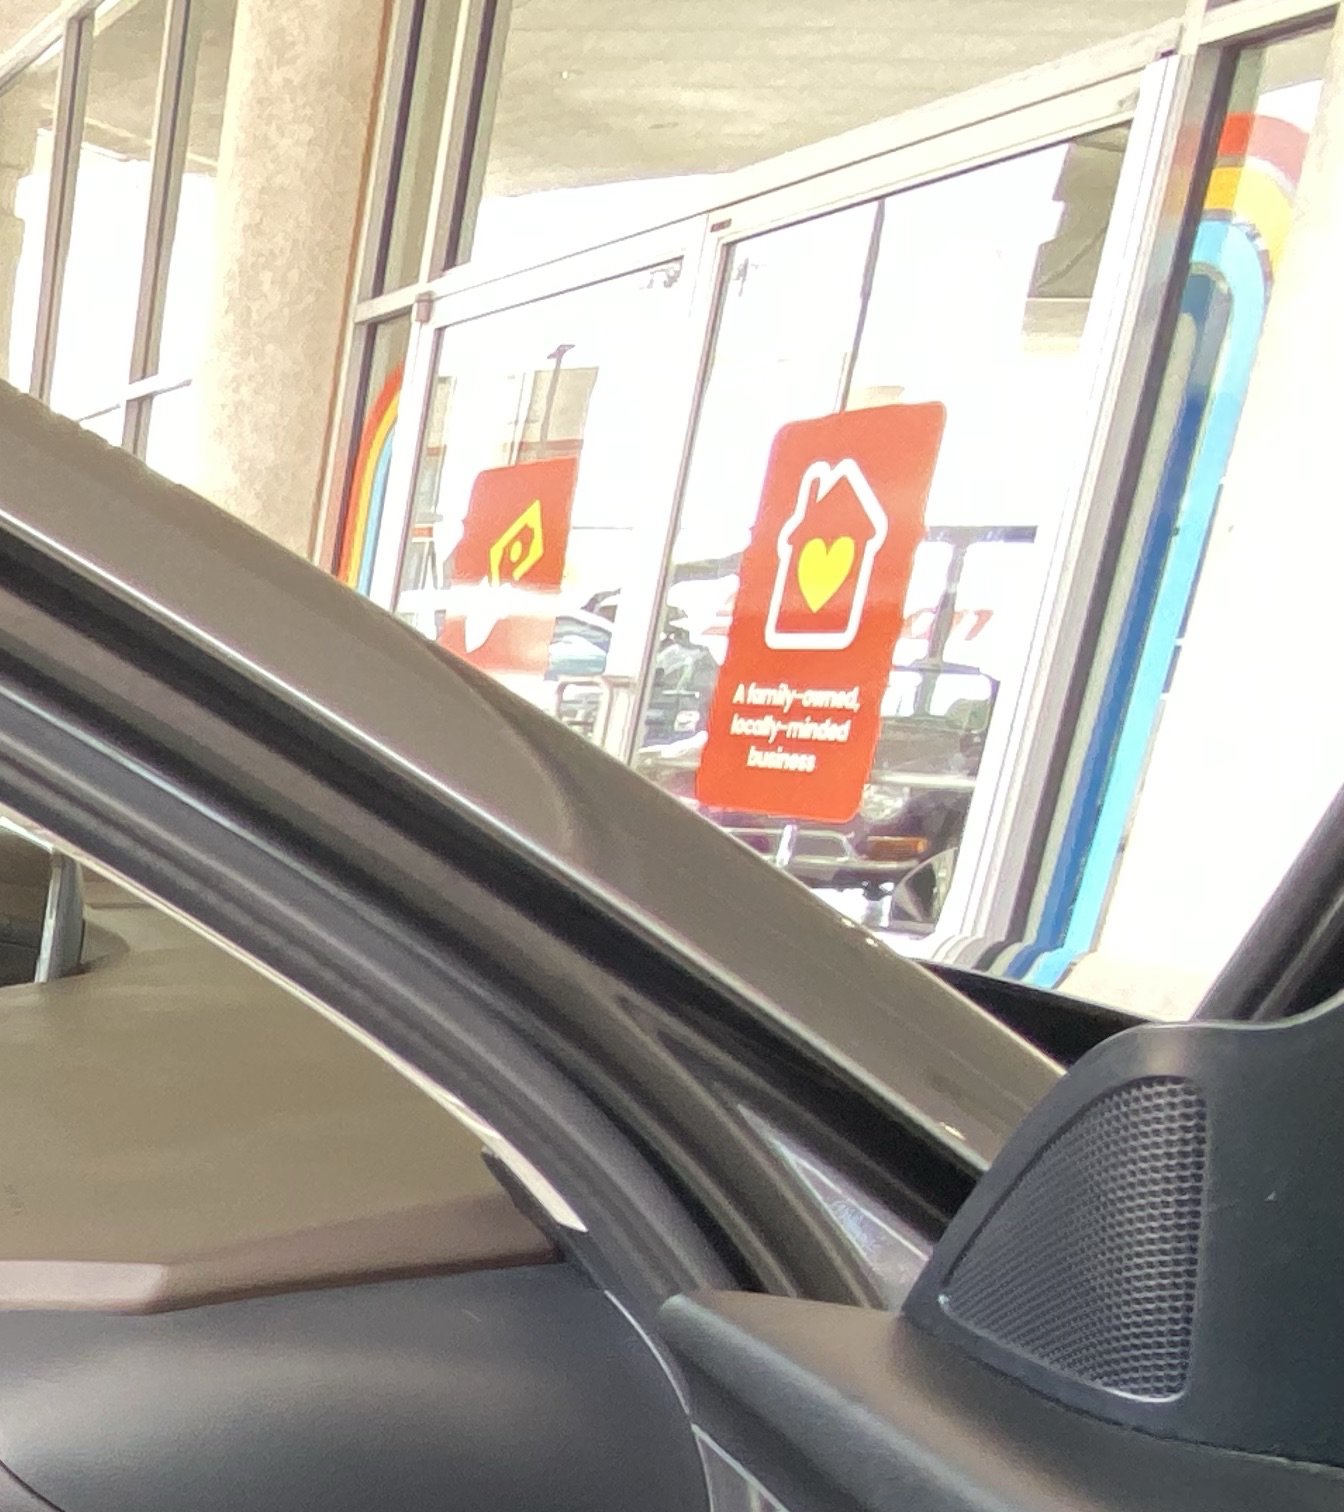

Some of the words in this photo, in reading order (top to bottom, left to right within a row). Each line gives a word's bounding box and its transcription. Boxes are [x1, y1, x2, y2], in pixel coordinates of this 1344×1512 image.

[732, 683, 745, 704] A
[747, 682, 860, 713] family-owned,
[730, 713, 851, 744] locally-minded
[746, 746, 816, 773] business
